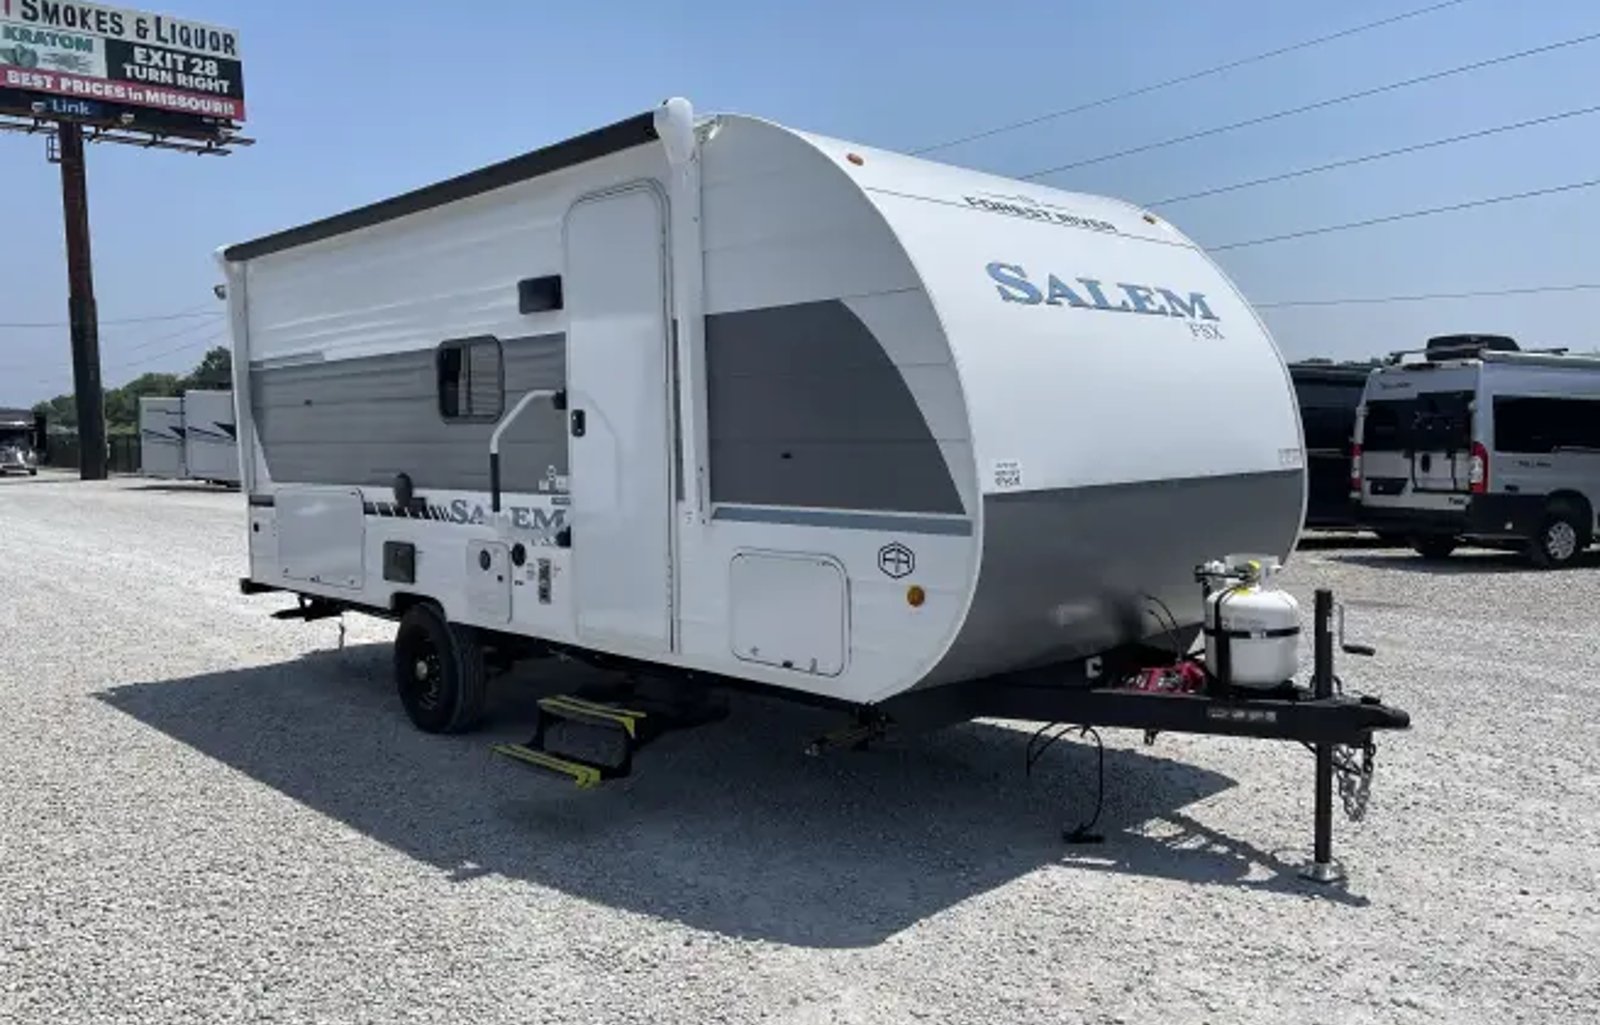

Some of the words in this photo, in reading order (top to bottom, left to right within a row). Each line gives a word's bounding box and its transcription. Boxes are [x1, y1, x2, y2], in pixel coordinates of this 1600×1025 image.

[3, 25, 93, 53] KRATOM
[136, 18, 149, 39] &
[155, 16, 235, 56] LIQUOR
[133, 45, 186, 71] EXIT
[190, 57, 218, 77] 28
[6, 70, 54, 89] BEST
[60, 77, 126, 99] PRICES
[122, 63, 173, 84] TURN
[176, 73, 230, 94] RIGHT
[52, 99, 91, 115] Link
[985, 261, 1220, 321] SALEM
